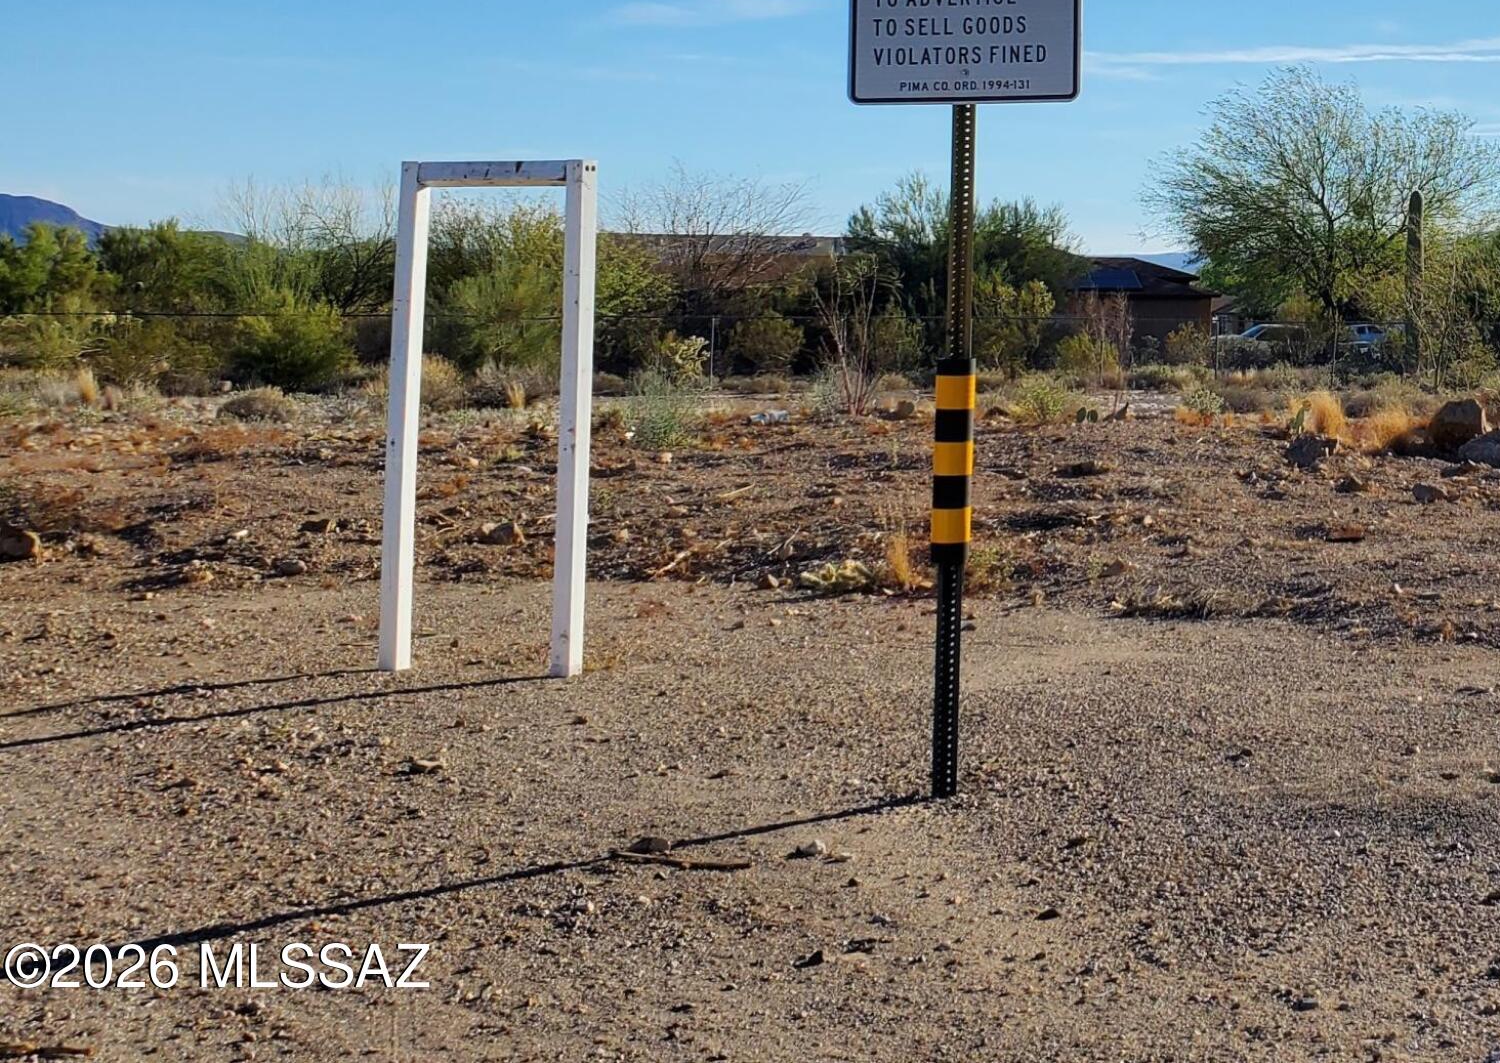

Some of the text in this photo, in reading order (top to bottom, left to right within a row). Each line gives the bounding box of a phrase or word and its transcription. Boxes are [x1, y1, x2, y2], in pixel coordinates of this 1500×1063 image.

[873, 16, 1027, 36] TO SELL GOODS
[874, 45, 1047, 65] VIOLATORS FINED
[900, 82, 929, 92] PIMA
